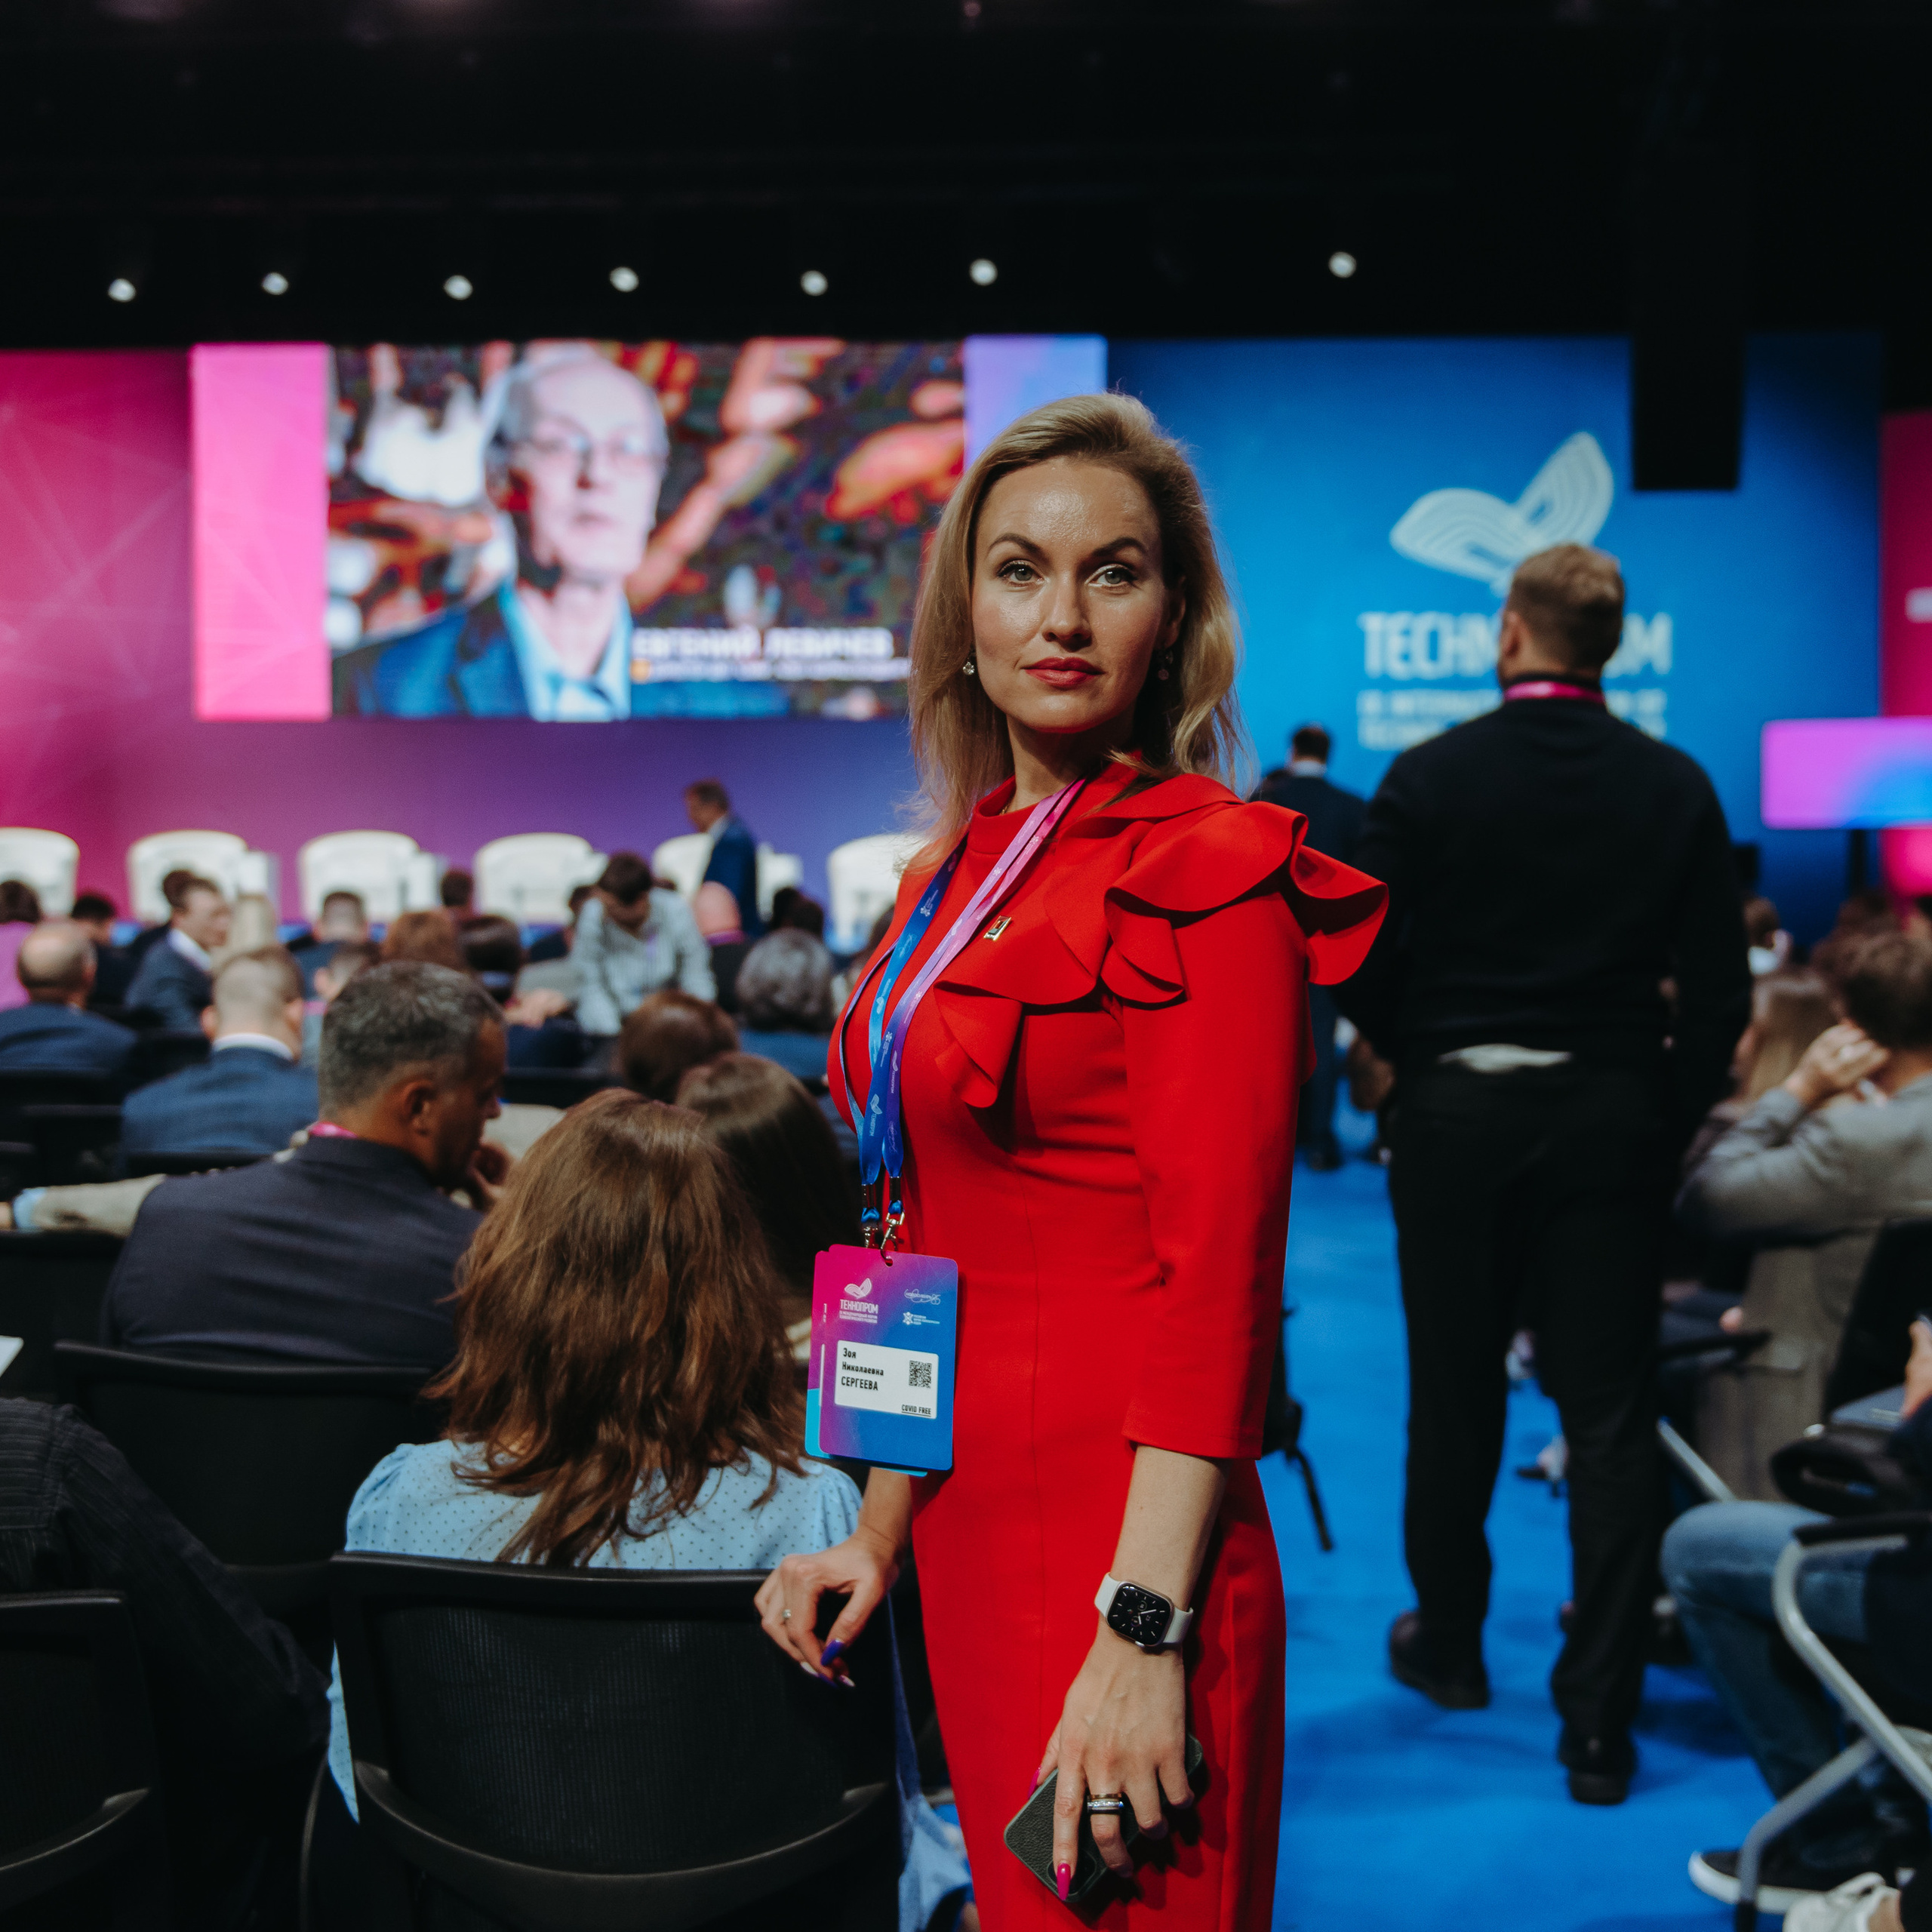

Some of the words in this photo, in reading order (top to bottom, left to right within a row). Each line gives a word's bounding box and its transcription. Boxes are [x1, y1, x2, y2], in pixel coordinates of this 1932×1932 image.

[839, 1299, 878, 1314] ТЕХНОПРОМ
[843, 1347, 857, 1358] Зоя
[841, 1361, 884, 1376] Николаевна
[841, 1376, 878, 1391] СЕРГЕЕВА
[901, 1404, 917, 1413] COVID
[918, 1406, 931, 1415] FREE
